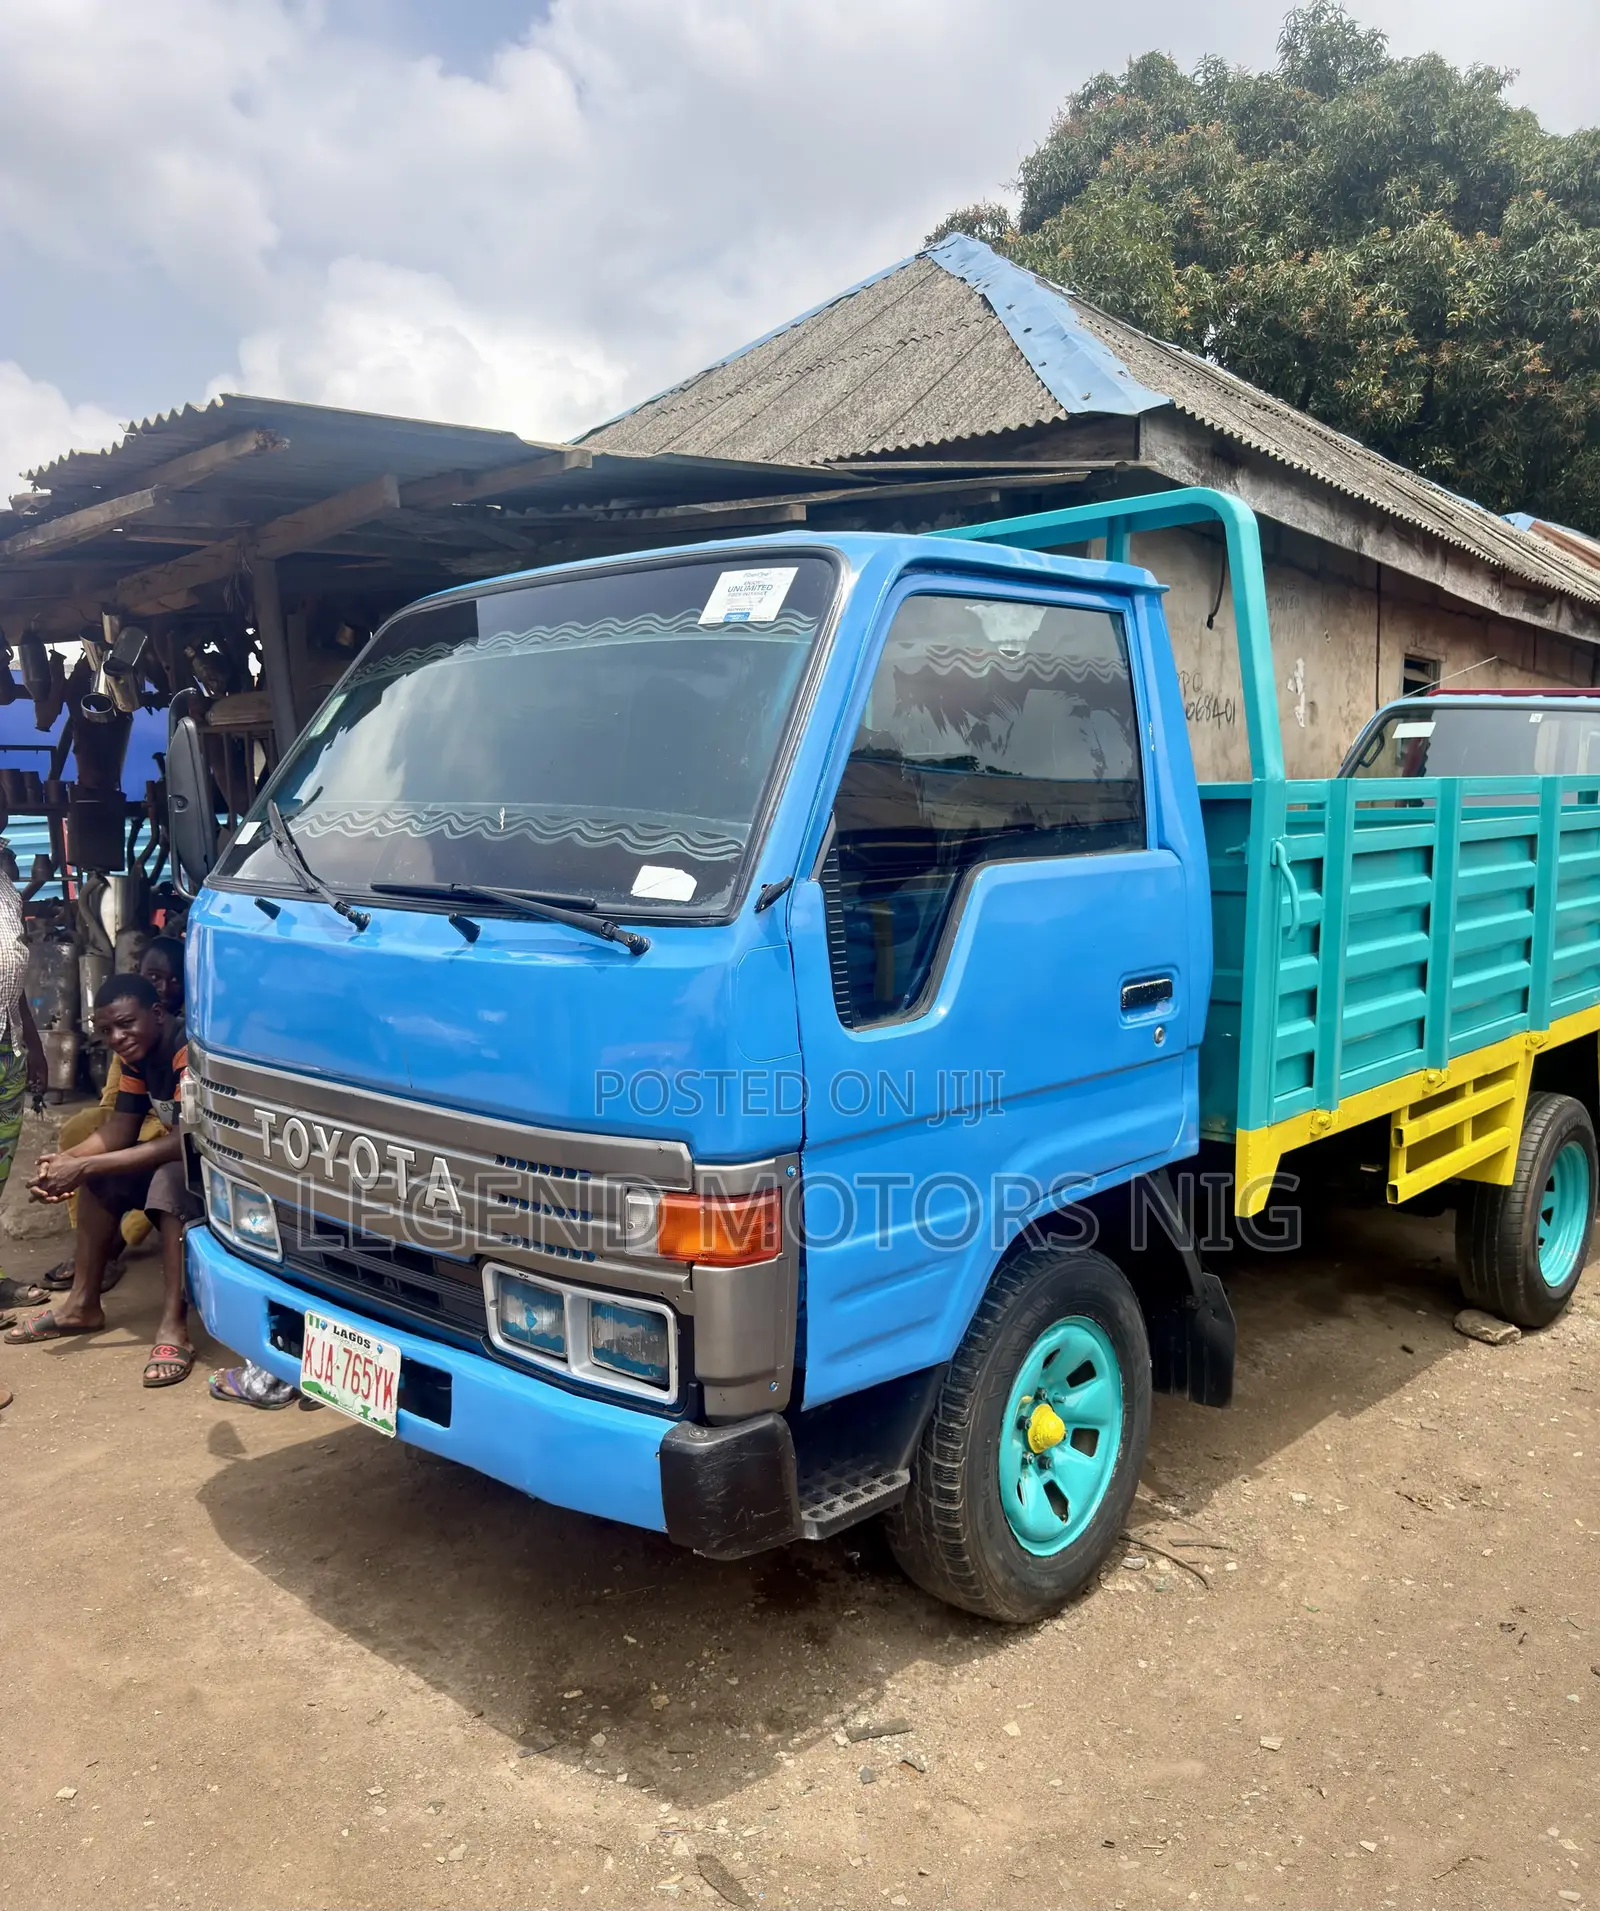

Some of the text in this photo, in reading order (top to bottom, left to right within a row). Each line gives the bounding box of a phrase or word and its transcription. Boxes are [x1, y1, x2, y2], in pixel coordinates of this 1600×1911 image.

[727, 584, 773, 593] UNLIMITED
[254, 1108, 464, 1216] TOYOTA
[333, 1325, 371, 1350] LAGOS
